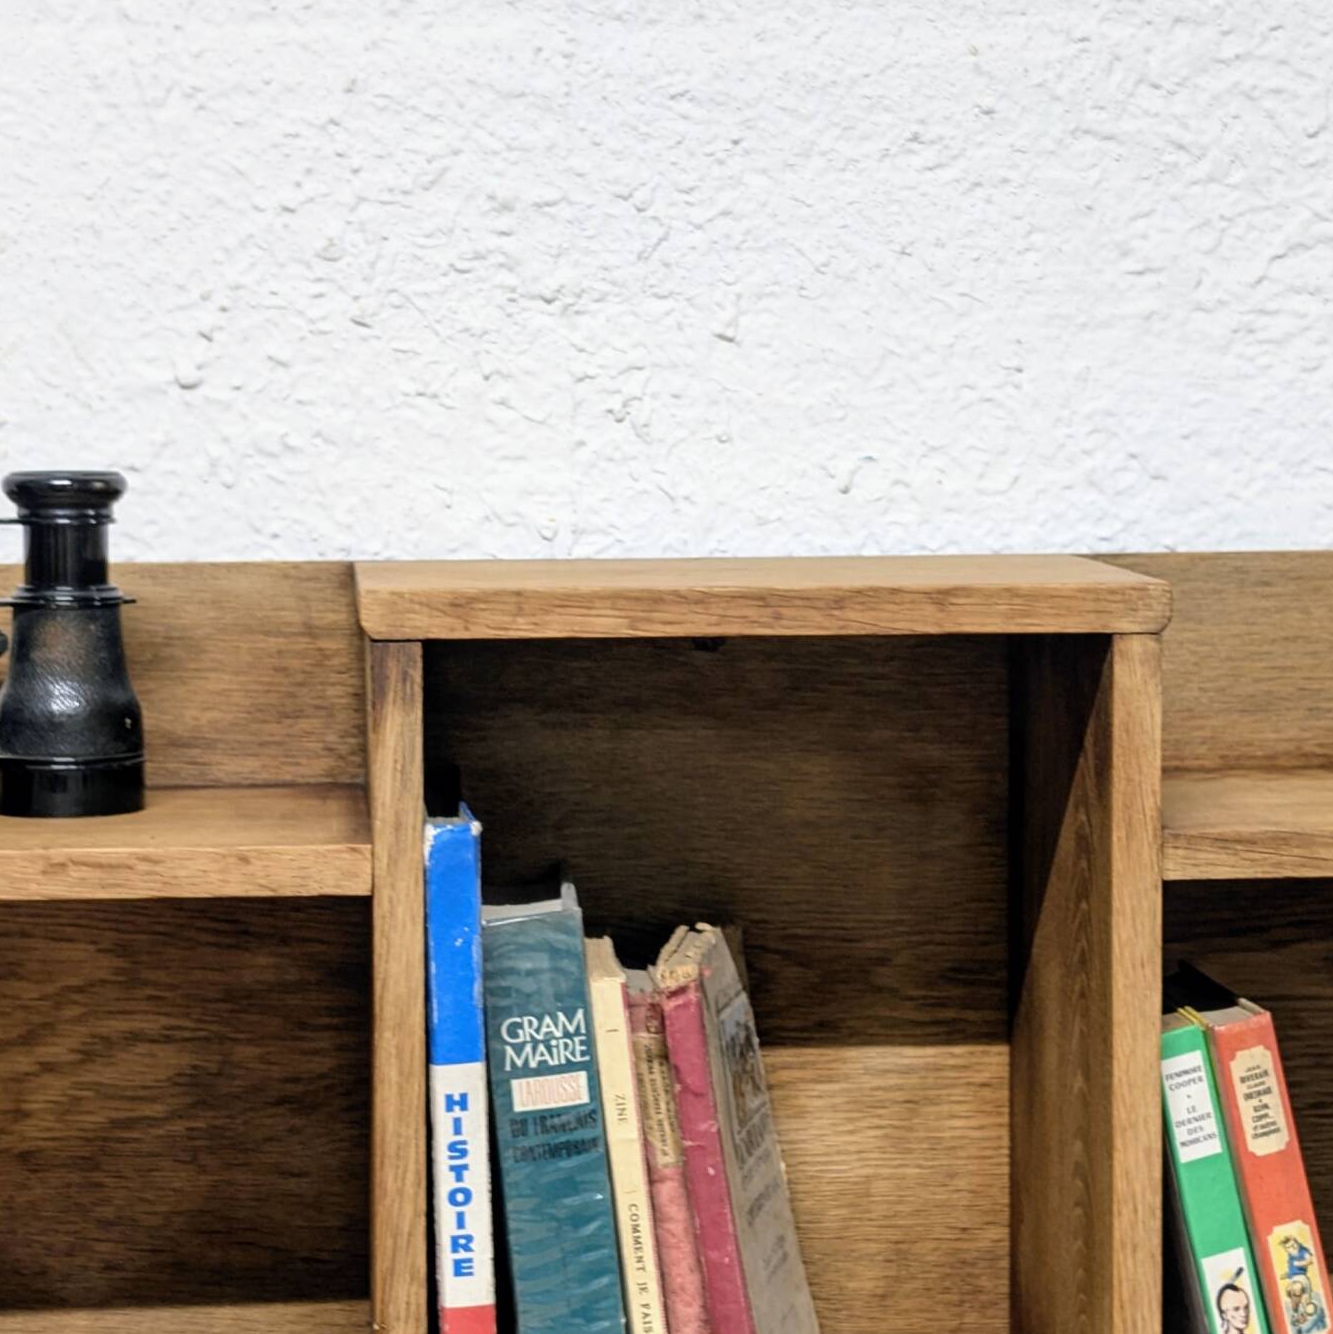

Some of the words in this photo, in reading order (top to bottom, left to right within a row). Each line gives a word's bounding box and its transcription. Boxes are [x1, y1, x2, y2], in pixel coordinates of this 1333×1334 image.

[500, 1008, 587, 1044] GRAM
[1168, 1075, 1204, 1092] COOPER
[444, 1092, 476, 1278] HISTOIRE
[628, 1203, 647, 1274] COMMENT
[639, 1302, 655, 1334] FAIS
